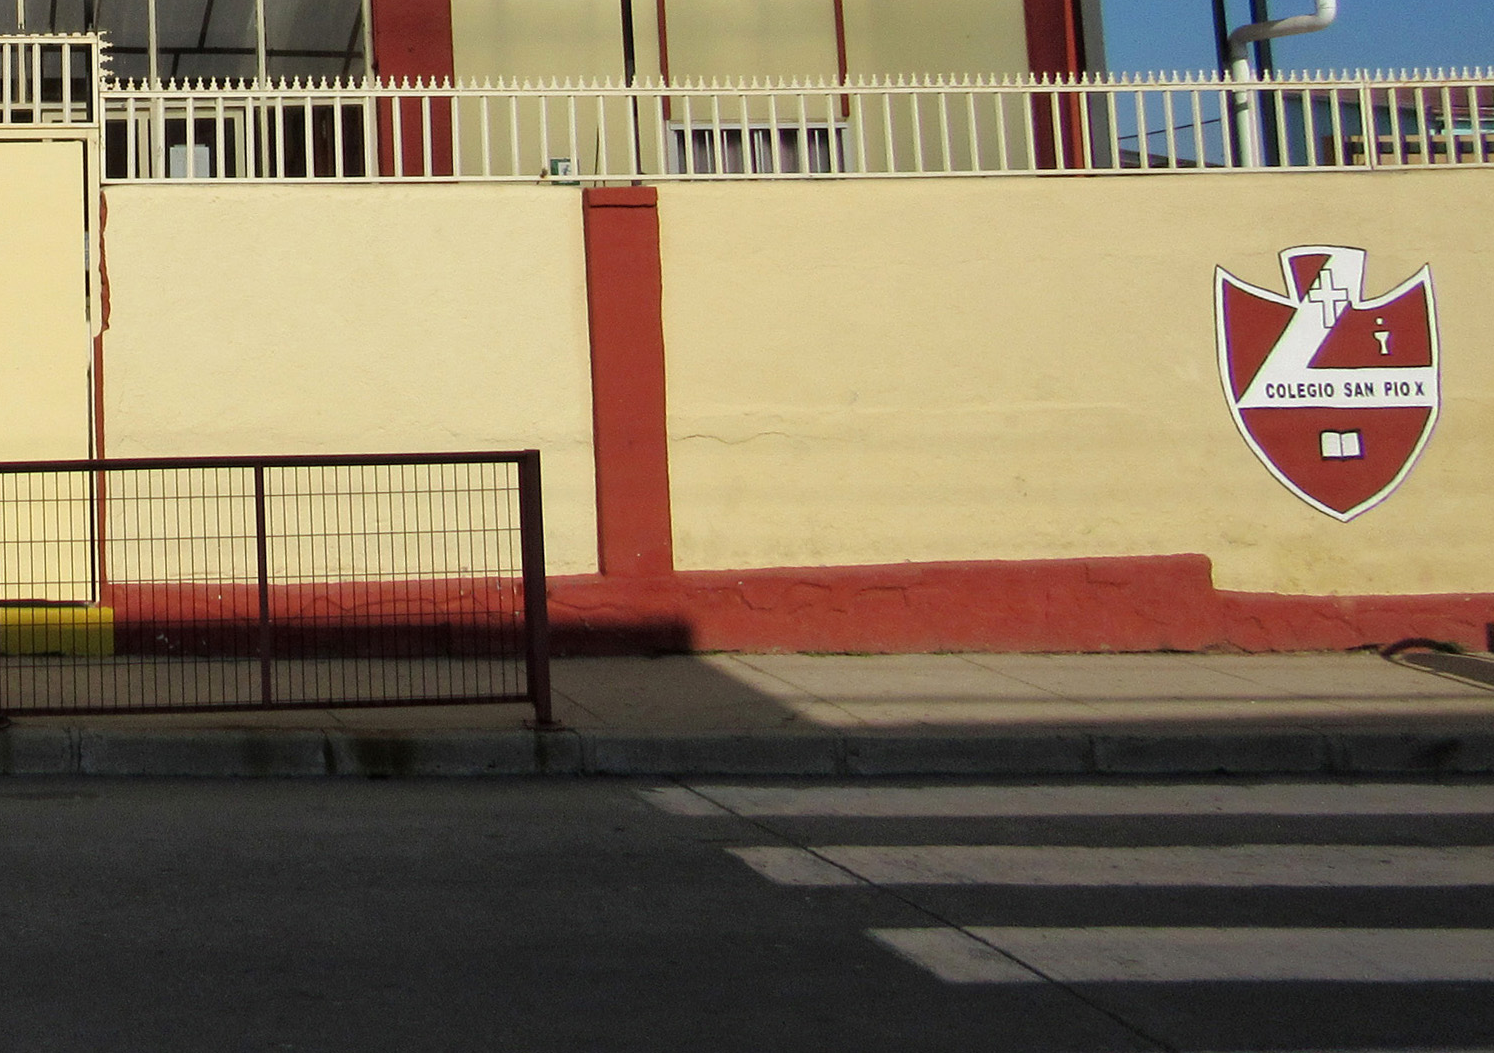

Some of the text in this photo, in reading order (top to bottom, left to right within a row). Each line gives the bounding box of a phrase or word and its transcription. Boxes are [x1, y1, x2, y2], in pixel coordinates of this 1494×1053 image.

[1265, 381, 1425, 398] COLEGIO SAN PIO X
